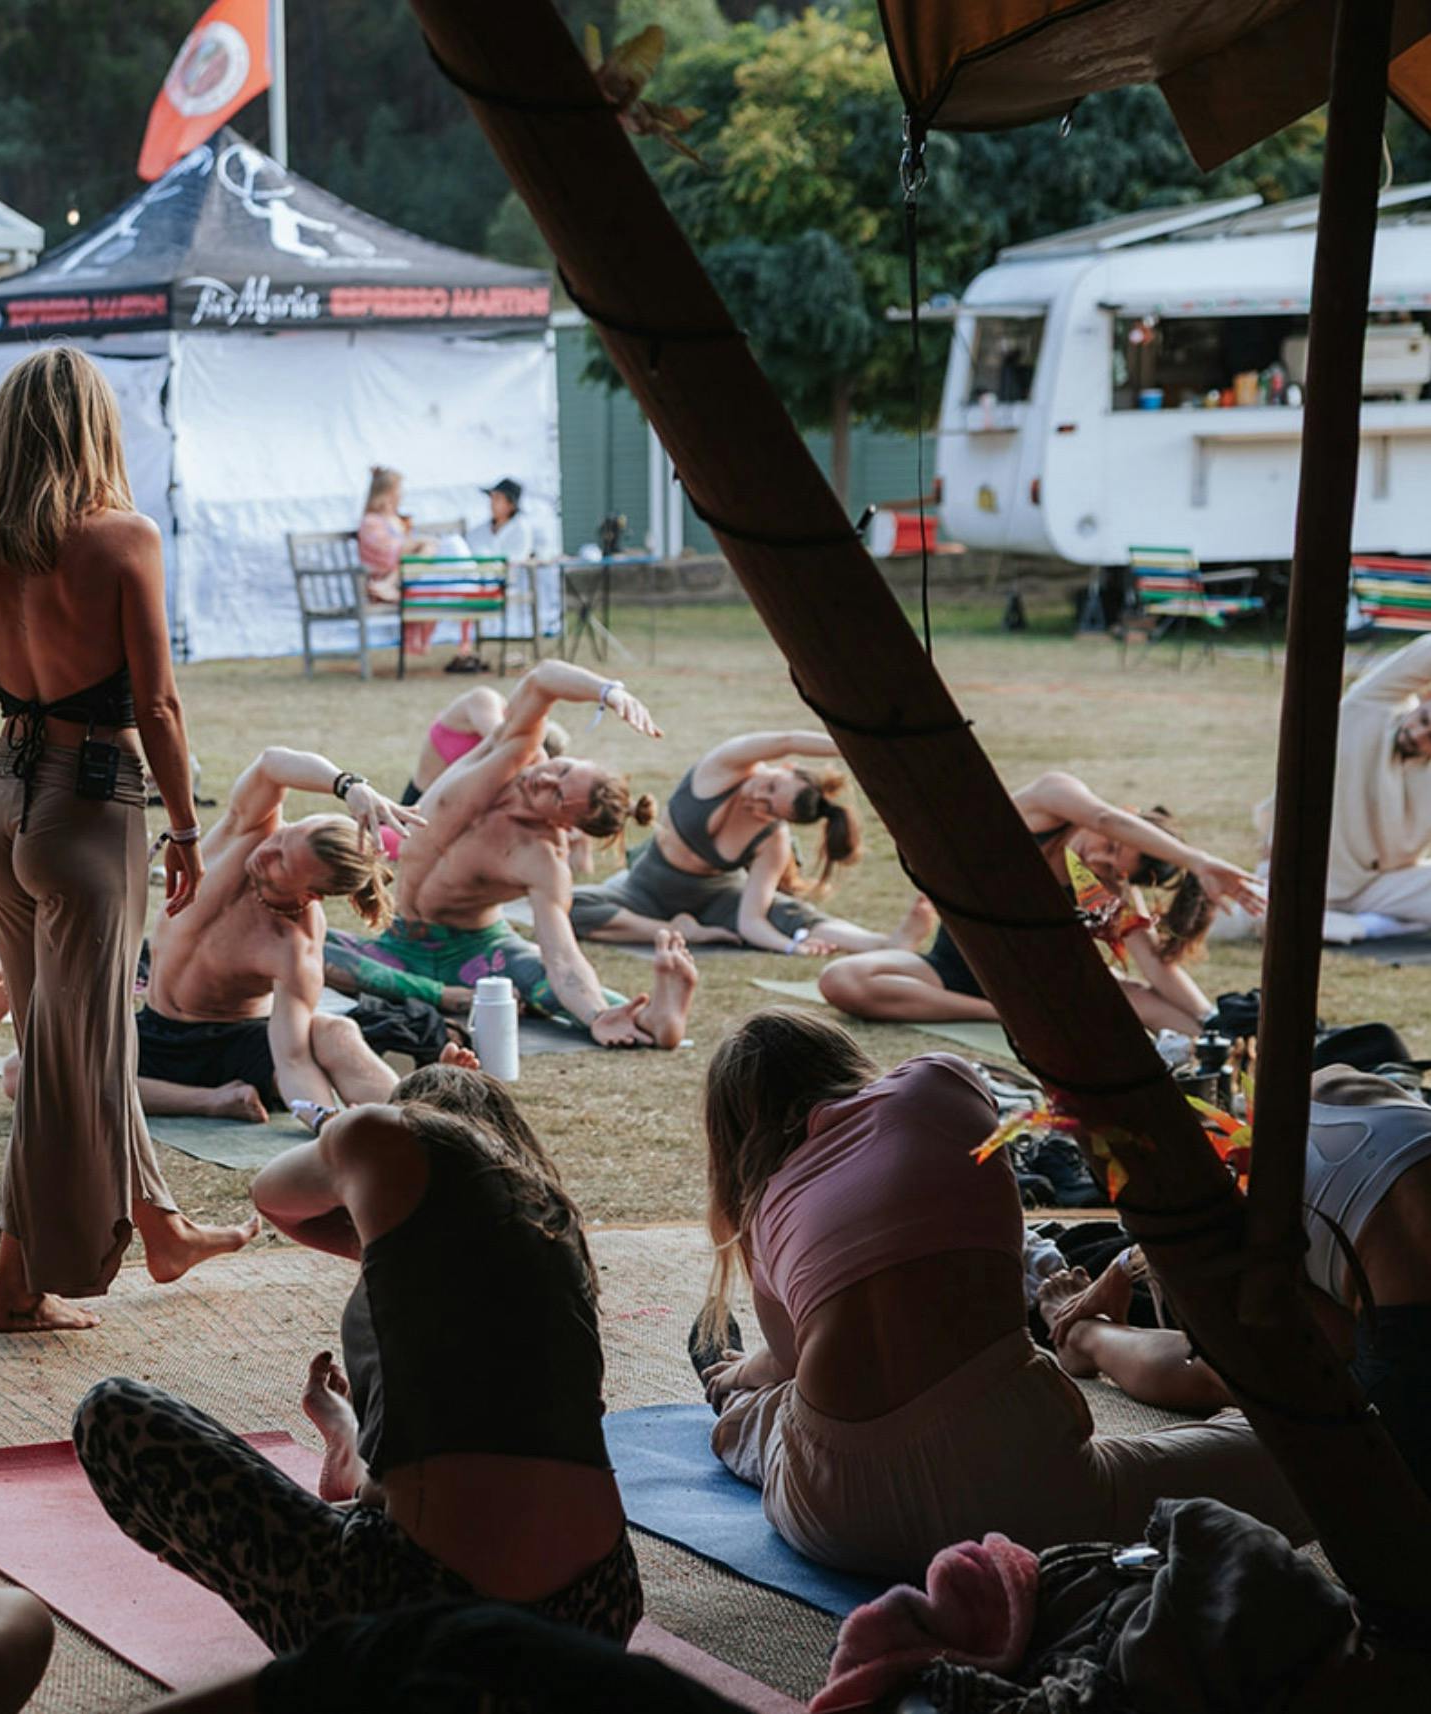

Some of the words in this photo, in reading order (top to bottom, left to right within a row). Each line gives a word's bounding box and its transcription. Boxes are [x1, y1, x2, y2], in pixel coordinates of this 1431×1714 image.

[227, 275, 320, 327] Maria
[329, 286, 449, 318] ESPRESSO
[452, 286, 549, 317] MARTINI
